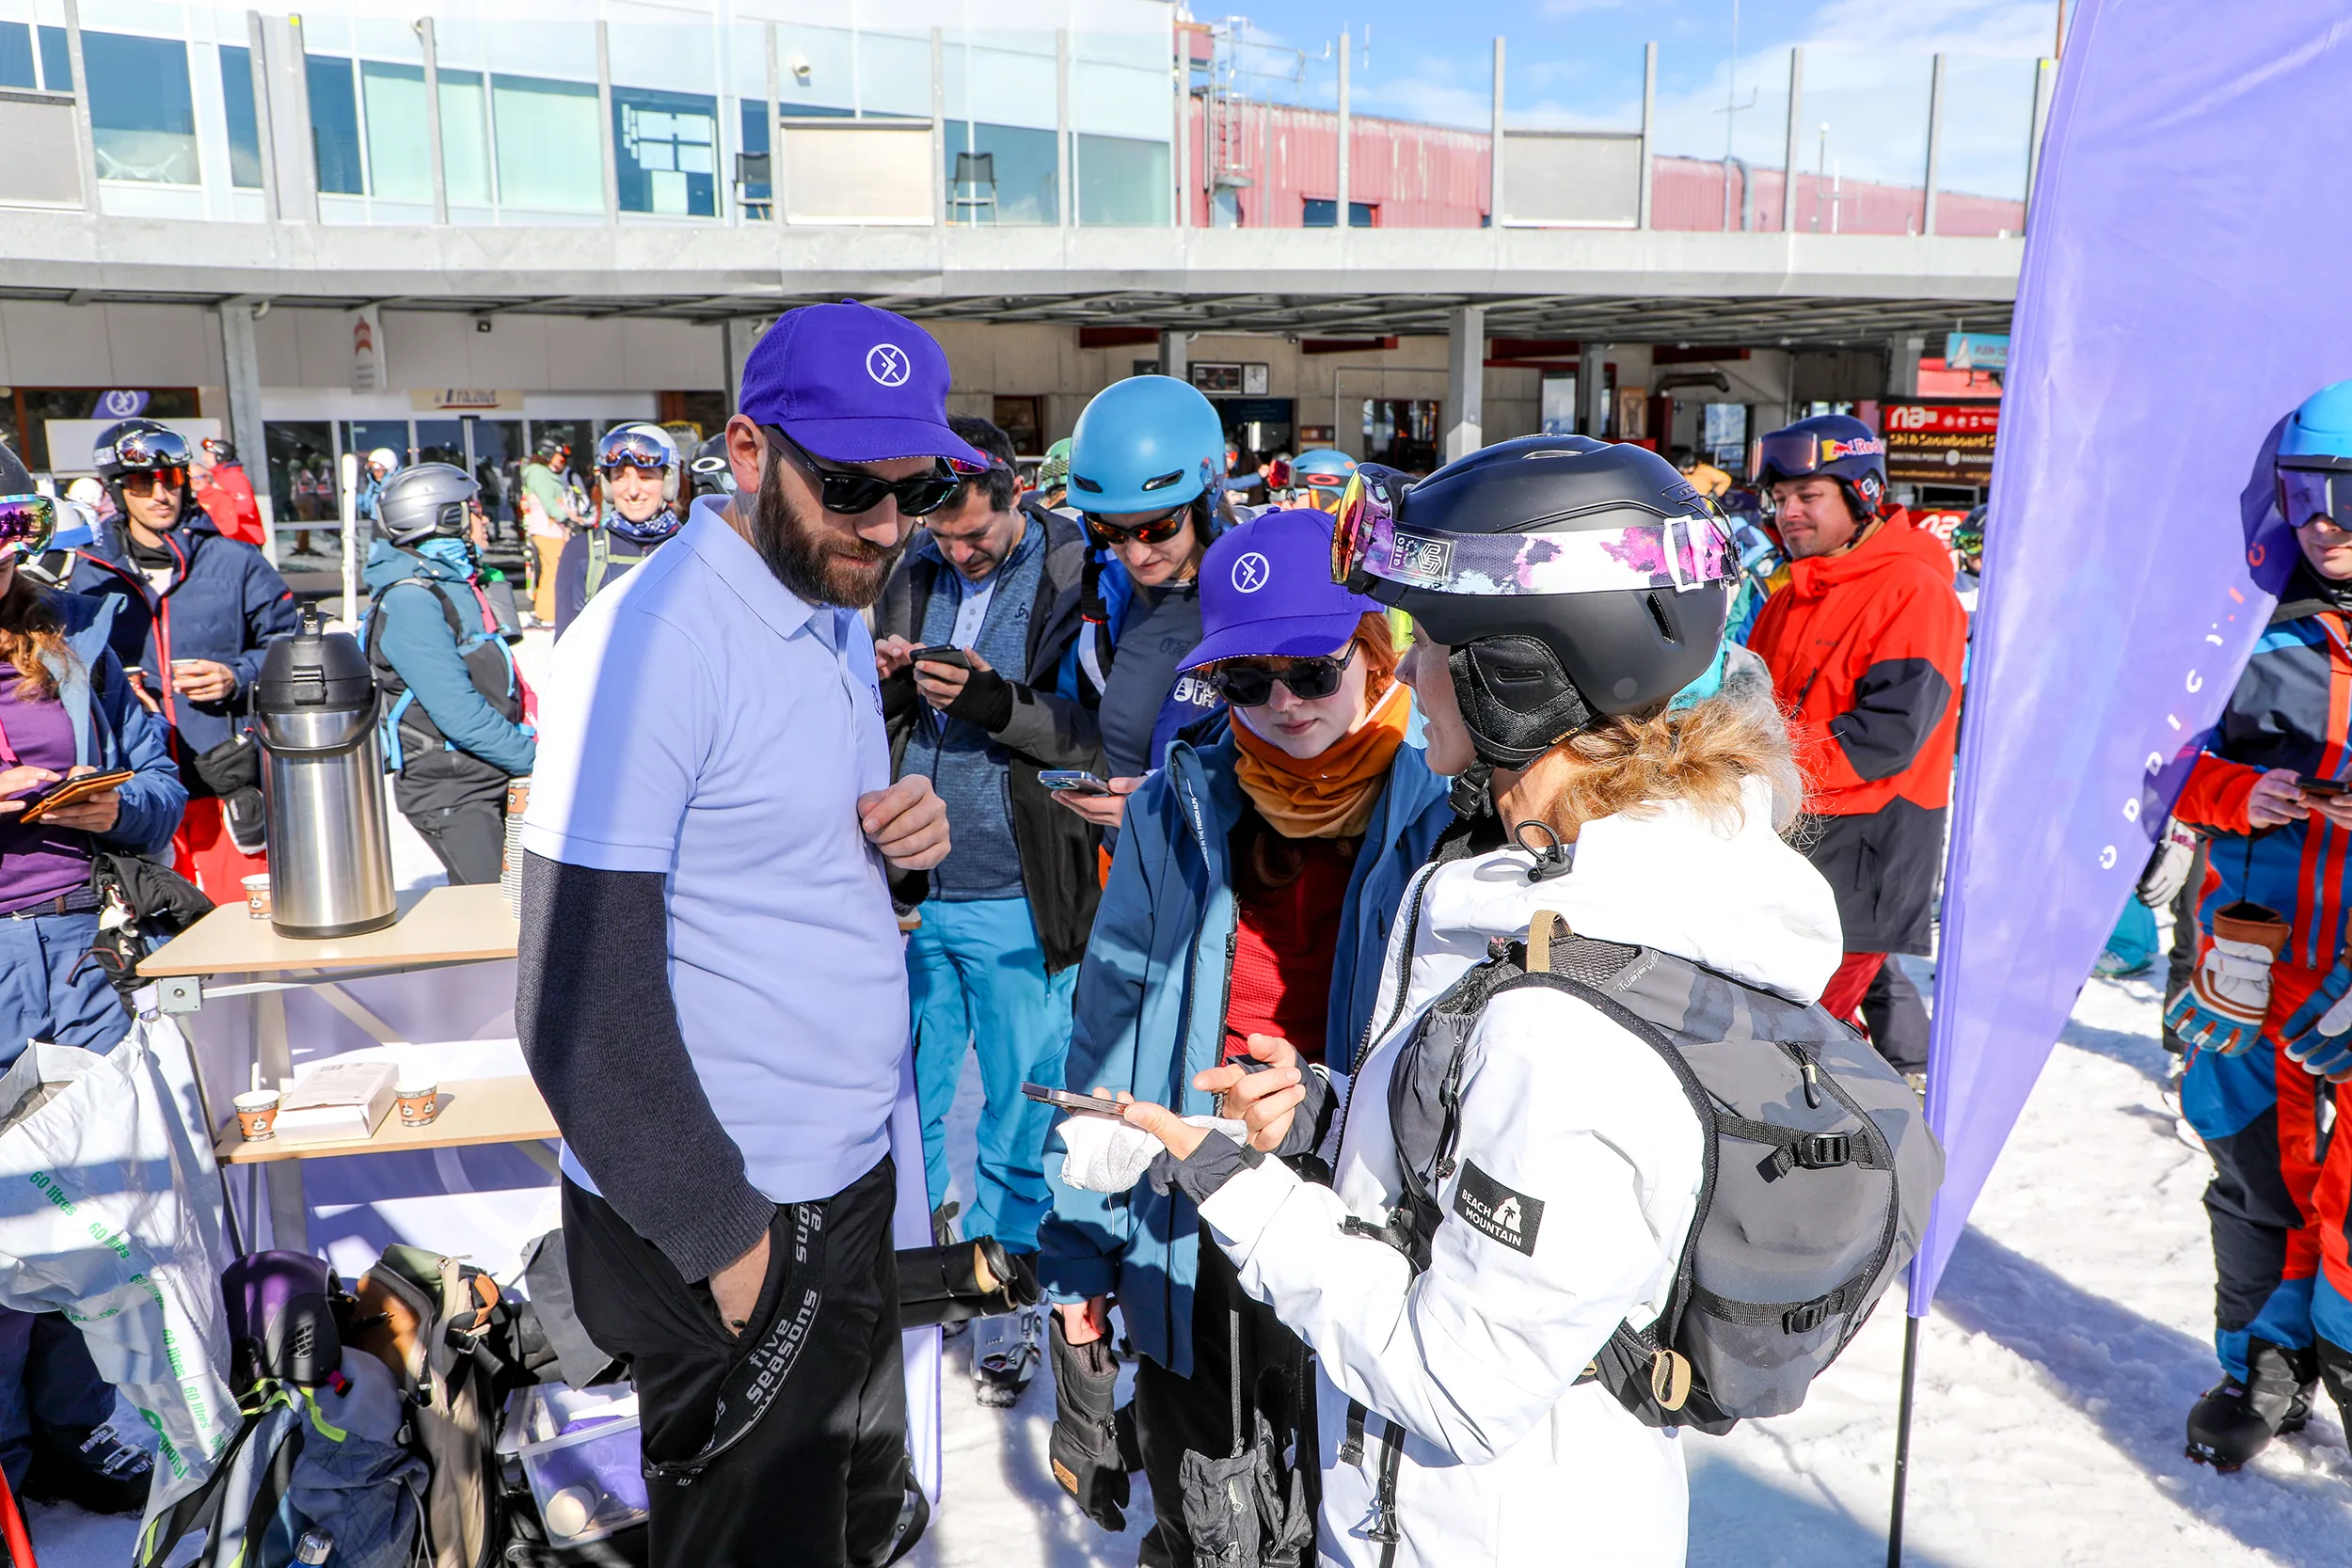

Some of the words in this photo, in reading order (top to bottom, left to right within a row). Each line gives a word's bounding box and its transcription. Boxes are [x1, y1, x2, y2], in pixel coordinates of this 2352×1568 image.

[1919, 434, 1987, 448] Snowboard
[1393, 537, 1405, 566] GIRO
[1550, 727, 1579, 744] GIRO
[29, 1170, 50, 1189] 60
[45, 1183, 77, 1216] litres
[1461, 1188, 1492, 1218] BEACH
[87, 1222, 107, 1241] 60
[103, 1234, 131, 1259] litres
[1465, 1207, 1522, 1247] MOUNTAIN
[130, 1273, 149, 1286] 60
[163, 1329, 175, 1346] 60
[746, 1289, 818, 1404] seasons
[749, 1319, 791, 1369] five
[166, 1343, 185, 1378] litres
[183, 1386, 199, 1401] 60
[191, 1401, 210, 1429] litres
